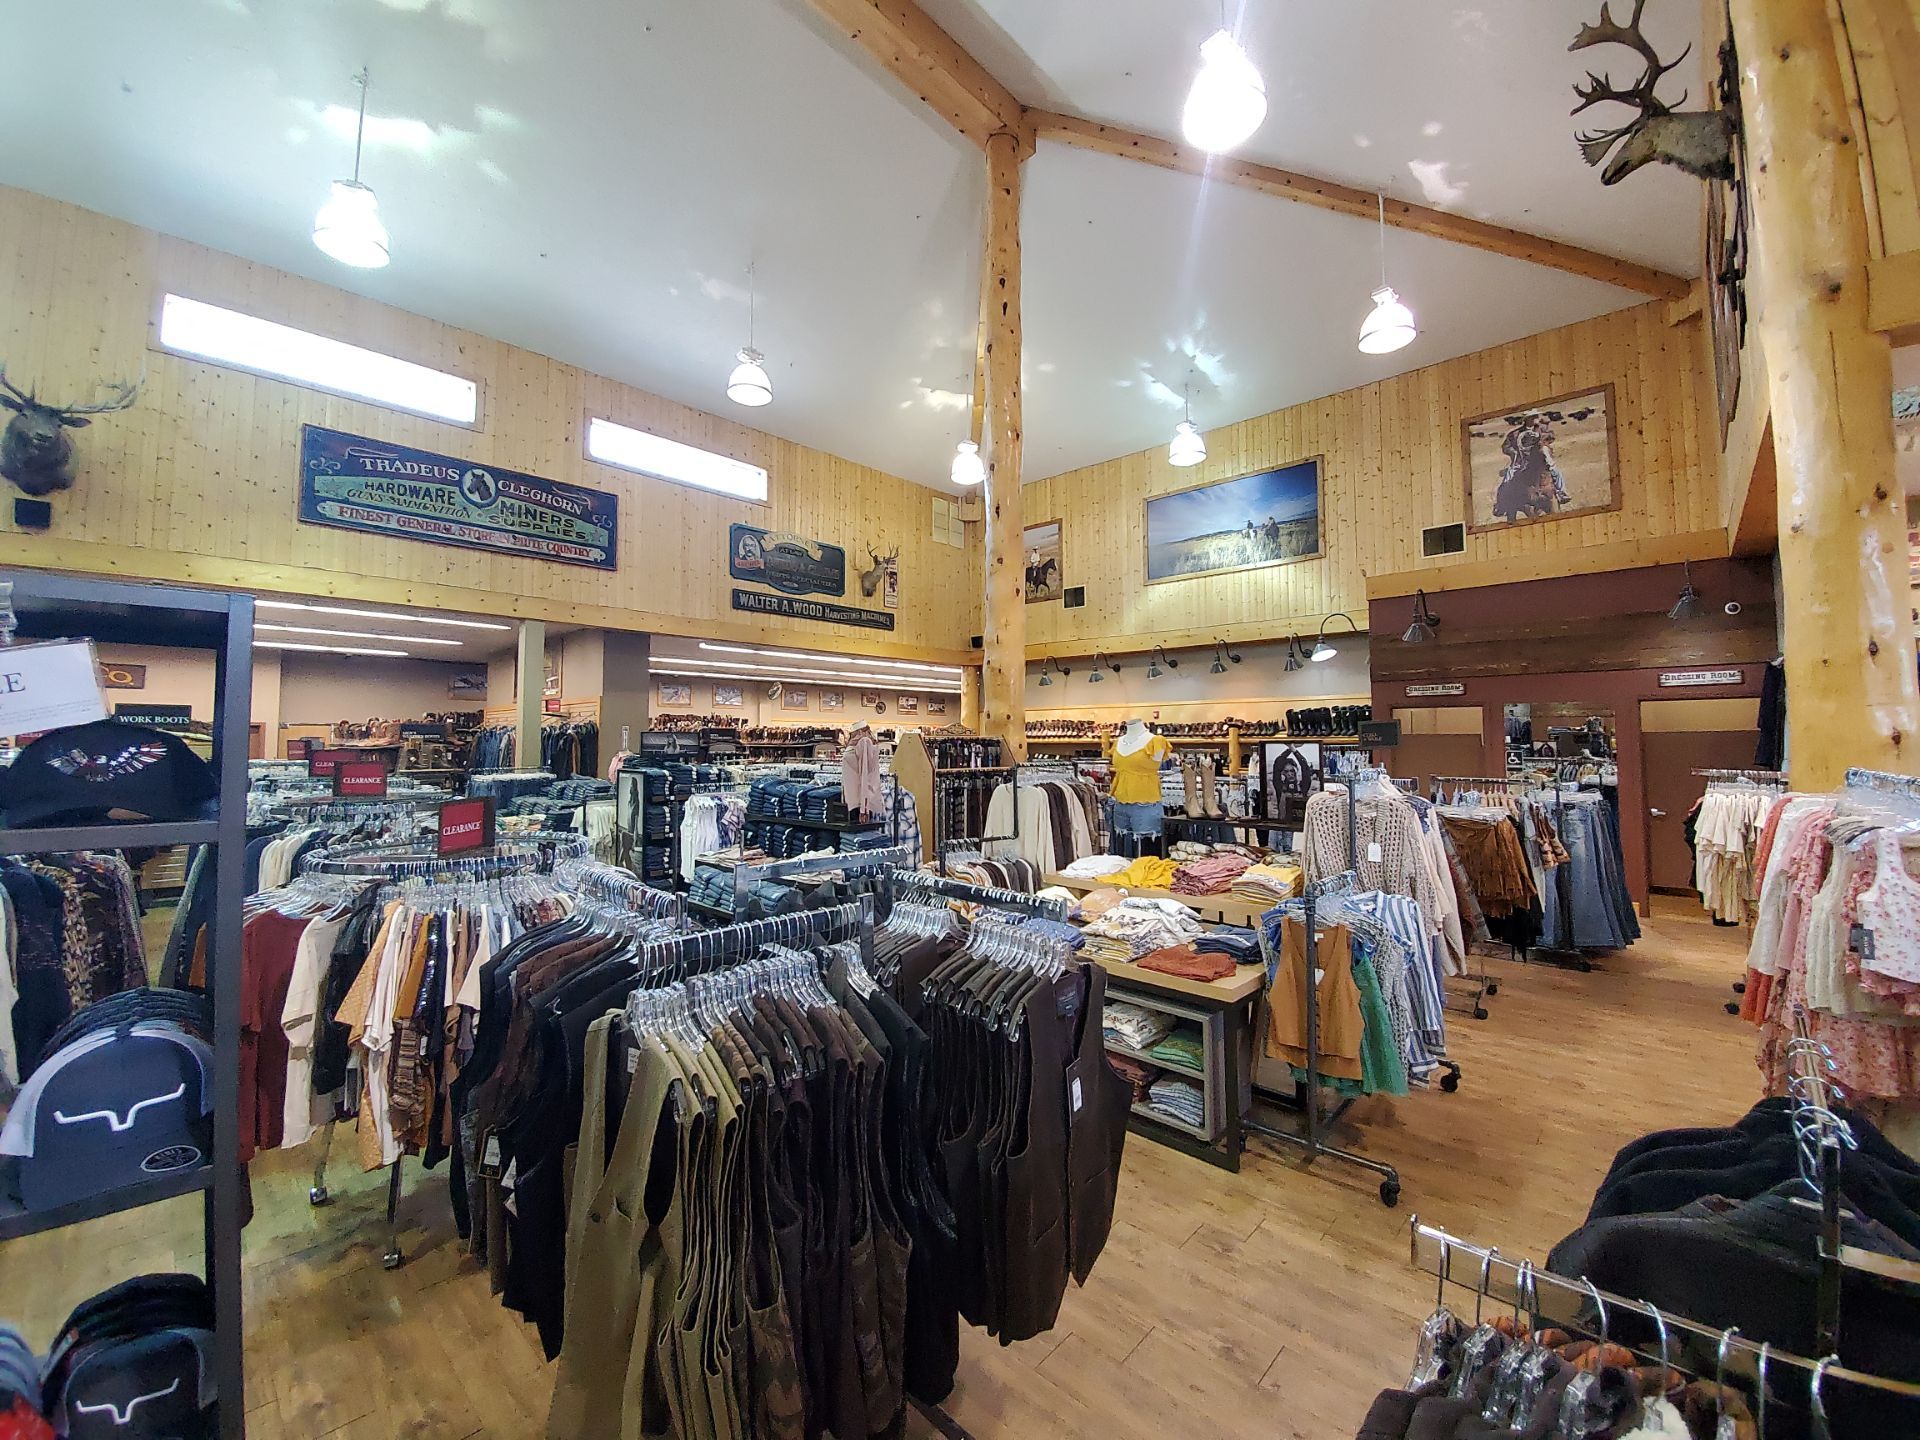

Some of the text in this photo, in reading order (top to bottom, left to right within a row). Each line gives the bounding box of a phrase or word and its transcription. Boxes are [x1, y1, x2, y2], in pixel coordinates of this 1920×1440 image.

[347, 488, 385, 502] GUNS
[360, 458, 583, 515] THADEUS CLEGHORN
[365, 481, 457, 506] HARDWARE
[500, 500, 575, 528] MINERS
[338, 505, 394, 524] FINEST
[397, 516, 457, 535] GENERAL
[546, 541, 592, 557] COUNTRY
[488, 514, 586, 540] SUPPLIES
[739, 593, 779, 611] WALTER
[824, 607, 861, 620] HARVESTING
[1710, 671, 1736, 679] ROOM
[119, 715, 190, 724] WORK BOOTS
[443, 820, 482, 836] CLEARANCE
